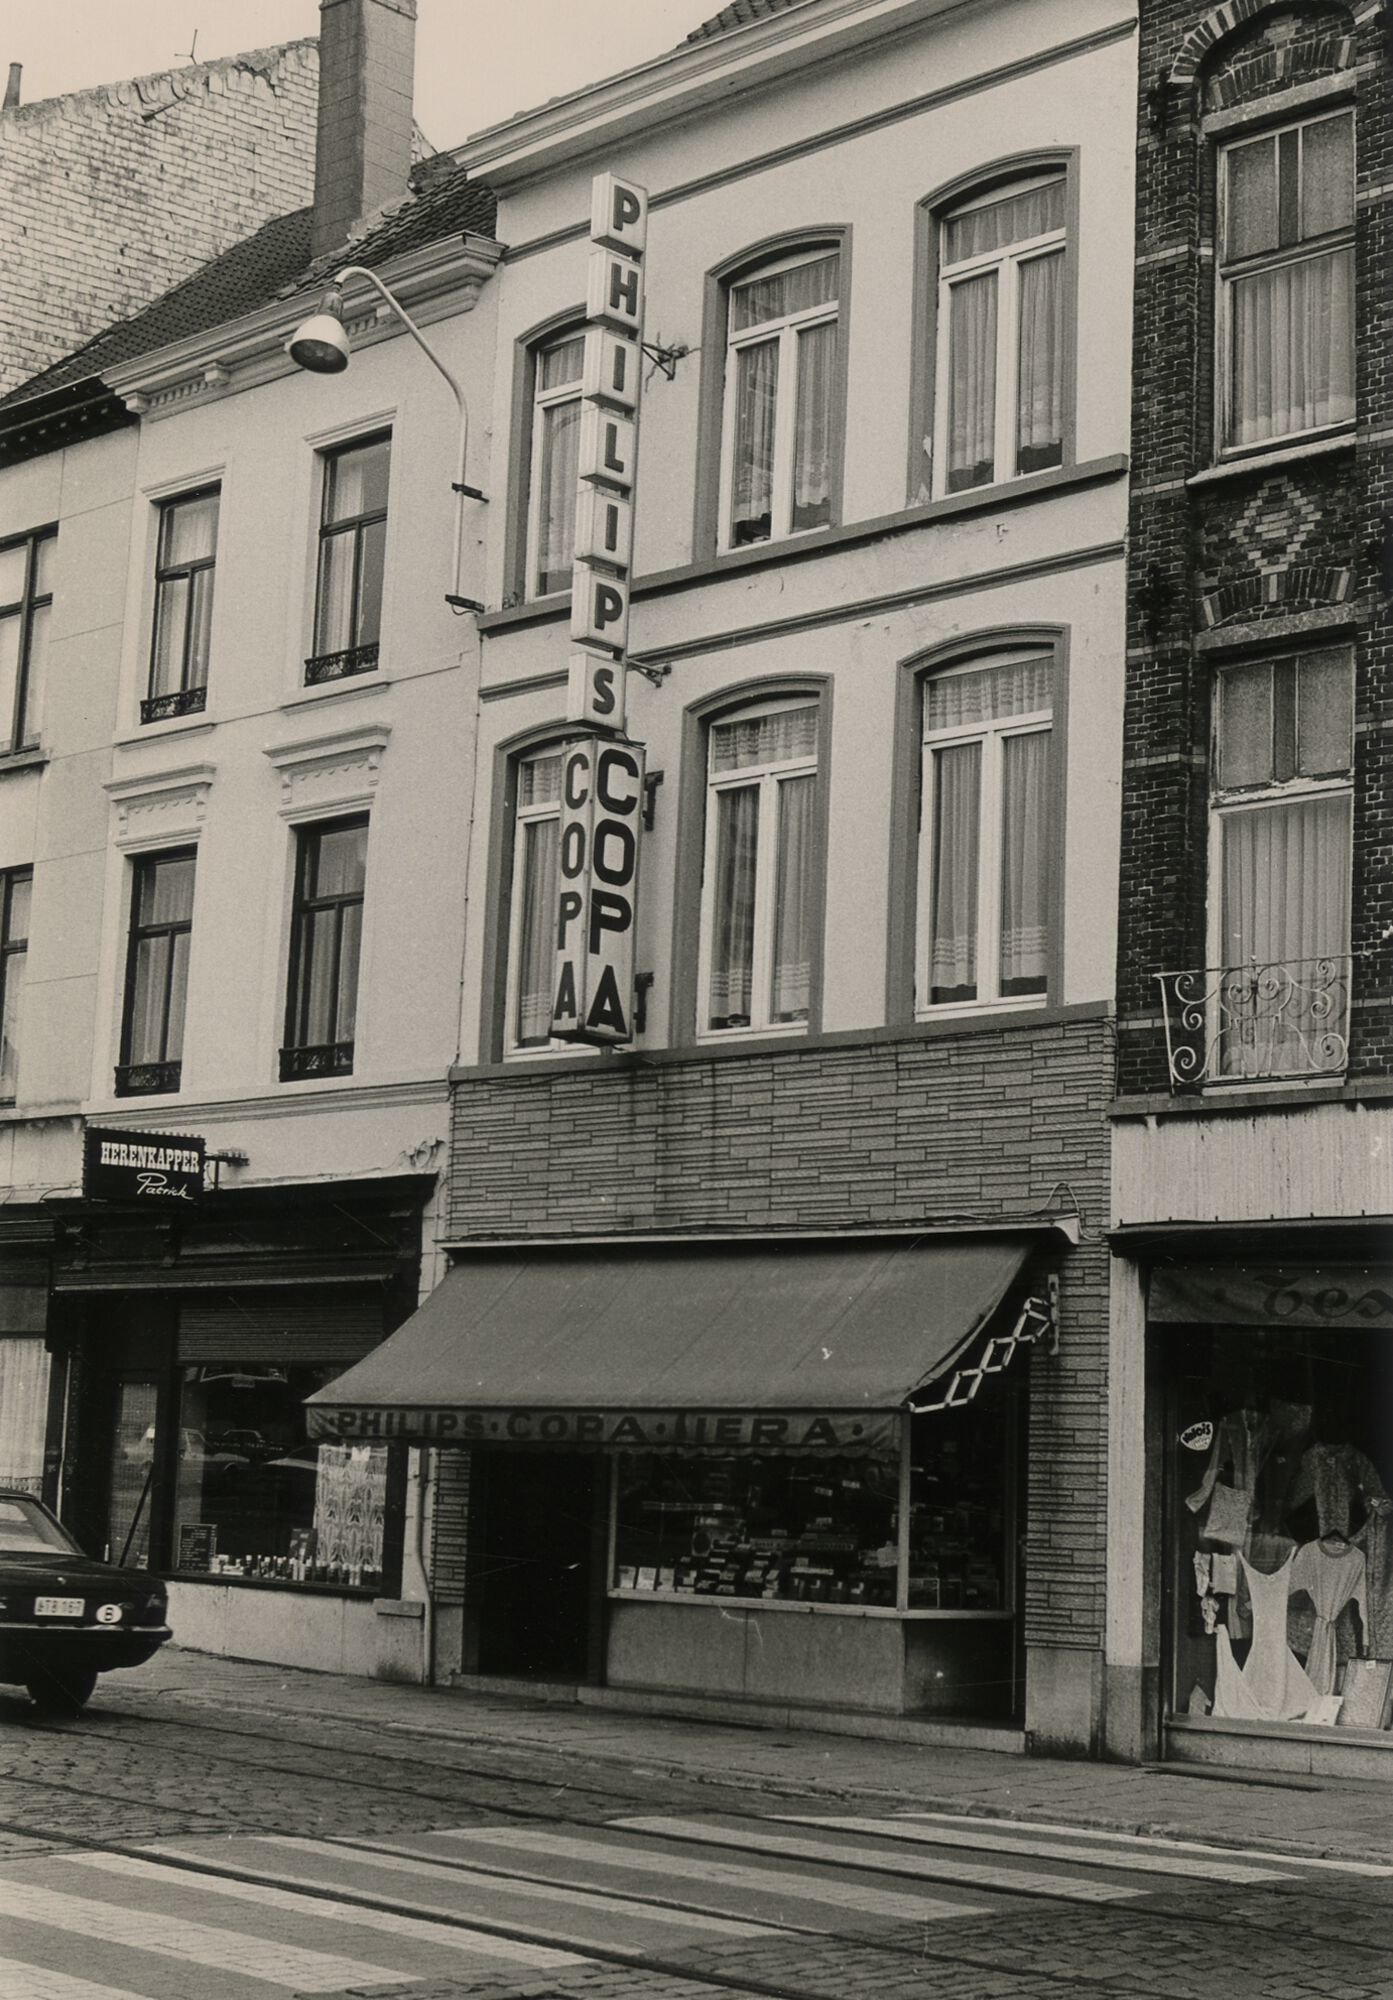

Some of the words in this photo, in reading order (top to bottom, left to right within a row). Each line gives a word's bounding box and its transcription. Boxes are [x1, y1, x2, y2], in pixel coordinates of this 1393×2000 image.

[593, 184, 641, 715] PHILIPS
[553, 752, 590, 1021] COPA
[586, 748, 640, 1035] COPA
[100, 1141, 200, 1174] HERENKAPPER
[136, 1172, 195, 1200] Patrick
[337, 1411, 485, 1437] PHILIPS
[506, 1411, 649, 1443] COPA
[104, 1606, 115, 1622] B
